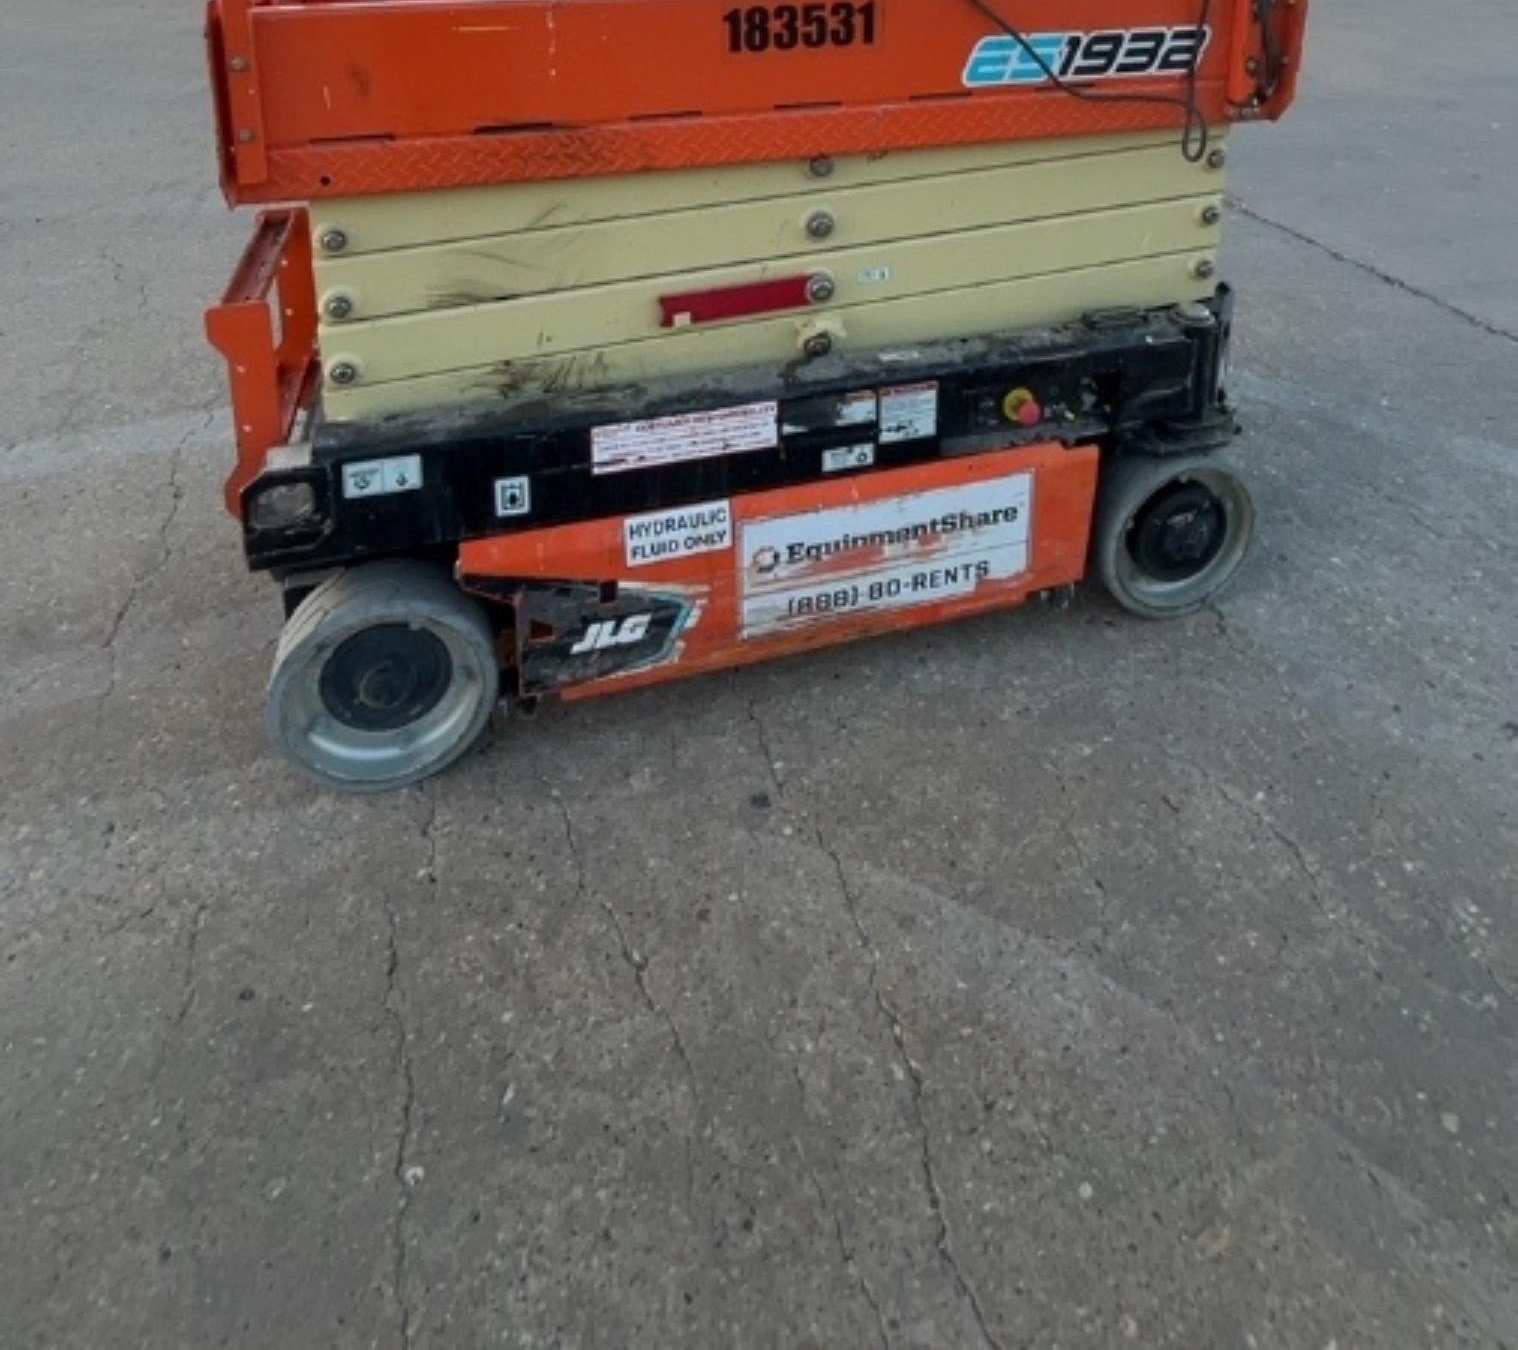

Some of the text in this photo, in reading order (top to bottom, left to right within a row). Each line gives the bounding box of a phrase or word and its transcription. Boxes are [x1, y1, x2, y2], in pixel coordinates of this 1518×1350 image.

[722, 0, 874, 52] 183531
[629, 507, 726, 540] HYDRAULIC
[631, 529, 727, 559] FLUID ONLY
[788, 560, 990, 616] (888) 80-RENTS
[570, 613, 652, 655] JLG
